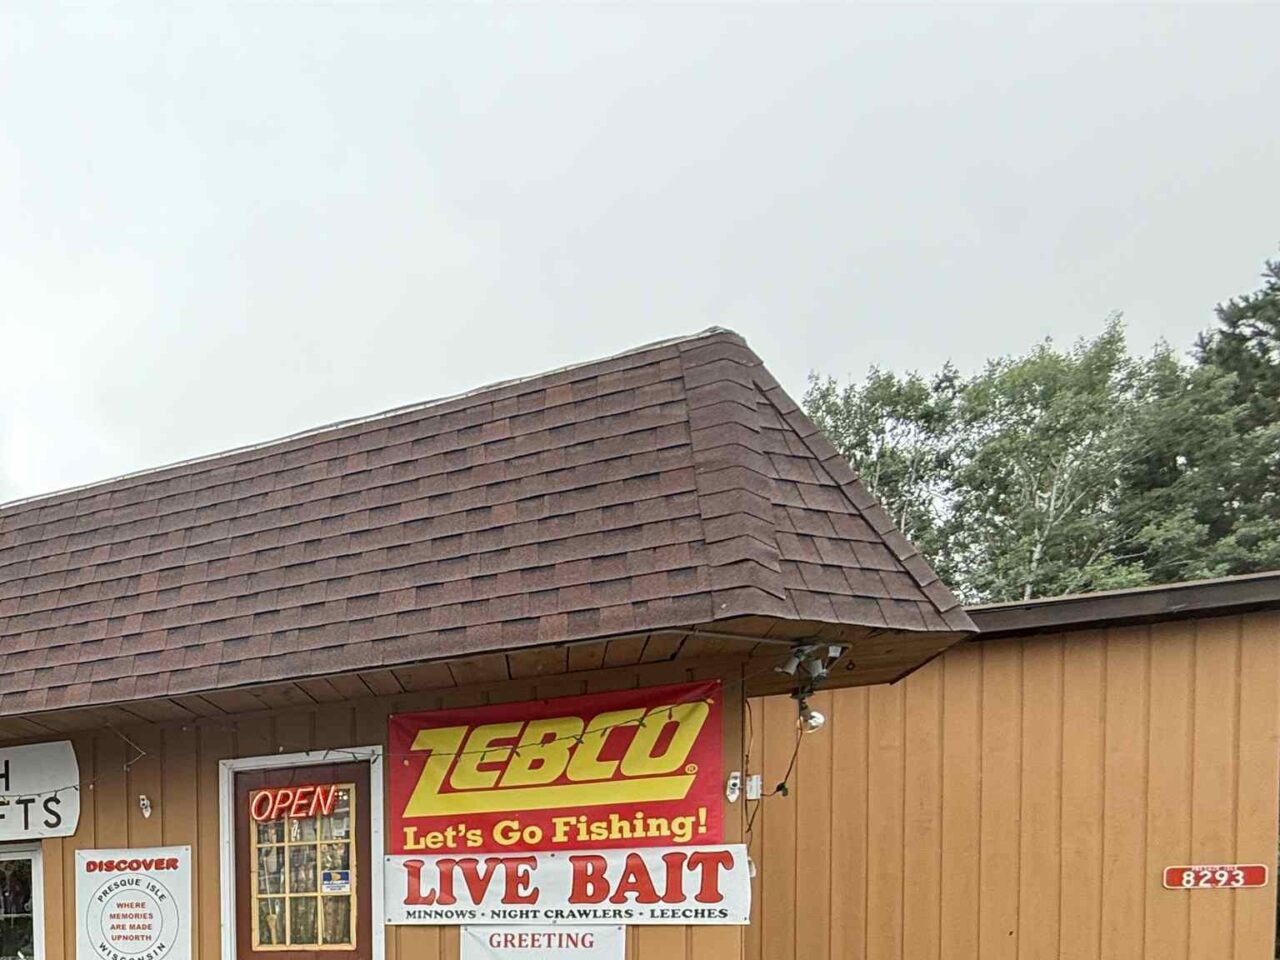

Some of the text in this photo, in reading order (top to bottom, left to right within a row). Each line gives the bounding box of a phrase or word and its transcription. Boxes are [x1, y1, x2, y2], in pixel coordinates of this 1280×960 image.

[401, 701, 710, 818] ZEBCO
[251, 785, 336, 821] OPEN
[403, 808, 708, 850] Let's Go Fishing!
[86, 858, 179, 873] DISCOVER
[403, 850, 735, 906] LIVE BAIT
[1182, 870, 1245, 887] 8293
[97, 878, 167, 902] PRESQUE ISLE
[109, 912, 154, 920] MEMORIES
[406, 908, 729, 920] MINNOWS NIGHT CRAWLERS LEECHES
[110, 923, 153, 931] ARE MADE
[489, 932, 595, 949] GREETING
